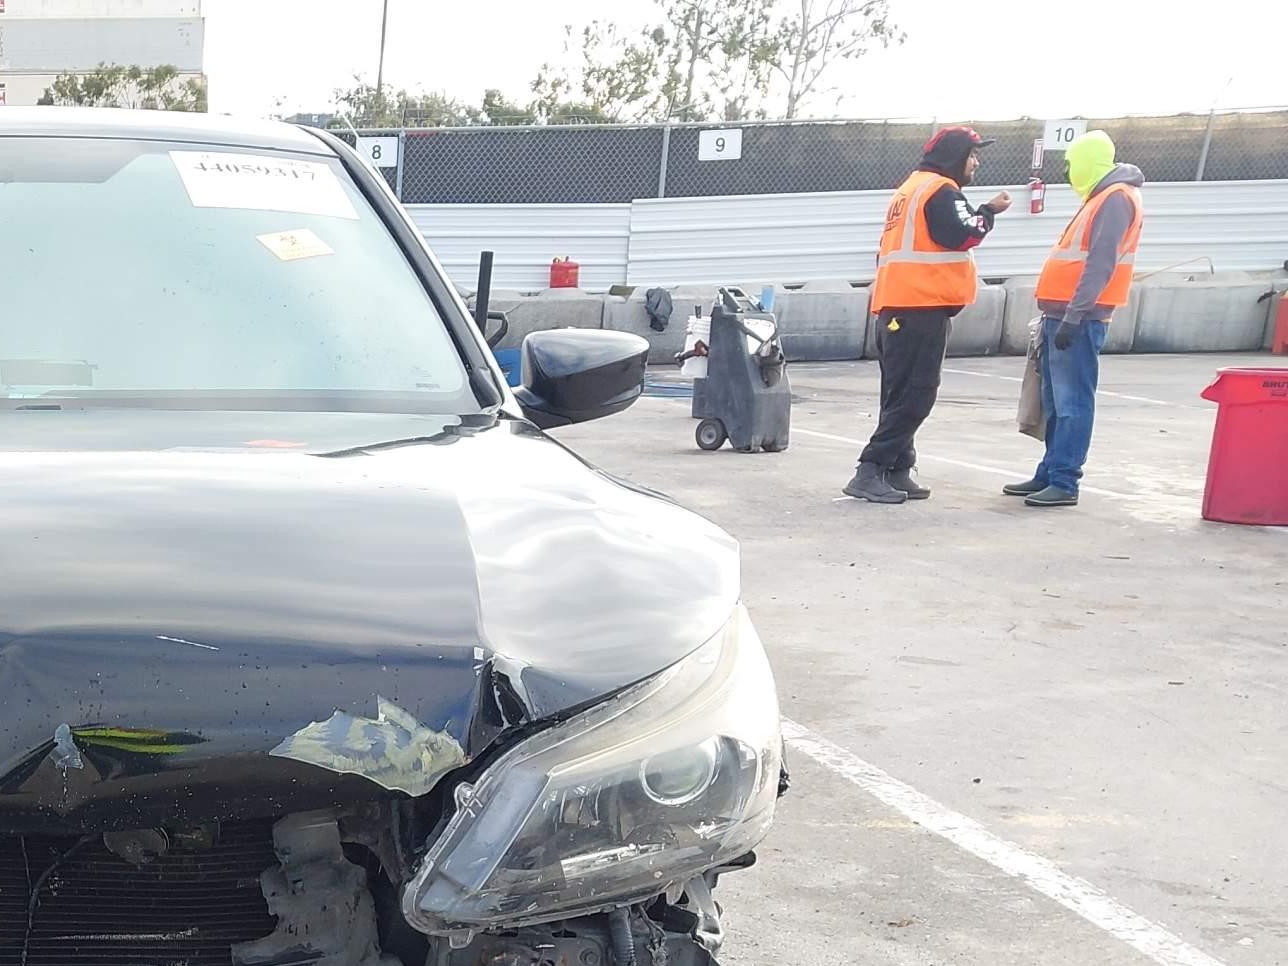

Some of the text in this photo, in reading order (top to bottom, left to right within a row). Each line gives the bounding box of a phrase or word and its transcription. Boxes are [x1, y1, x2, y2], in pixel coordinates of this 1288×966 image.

[1055, 127, 1075, 143] 10
[371, 144, 382, 160] 8
[715, 137, 726, 153] 9
